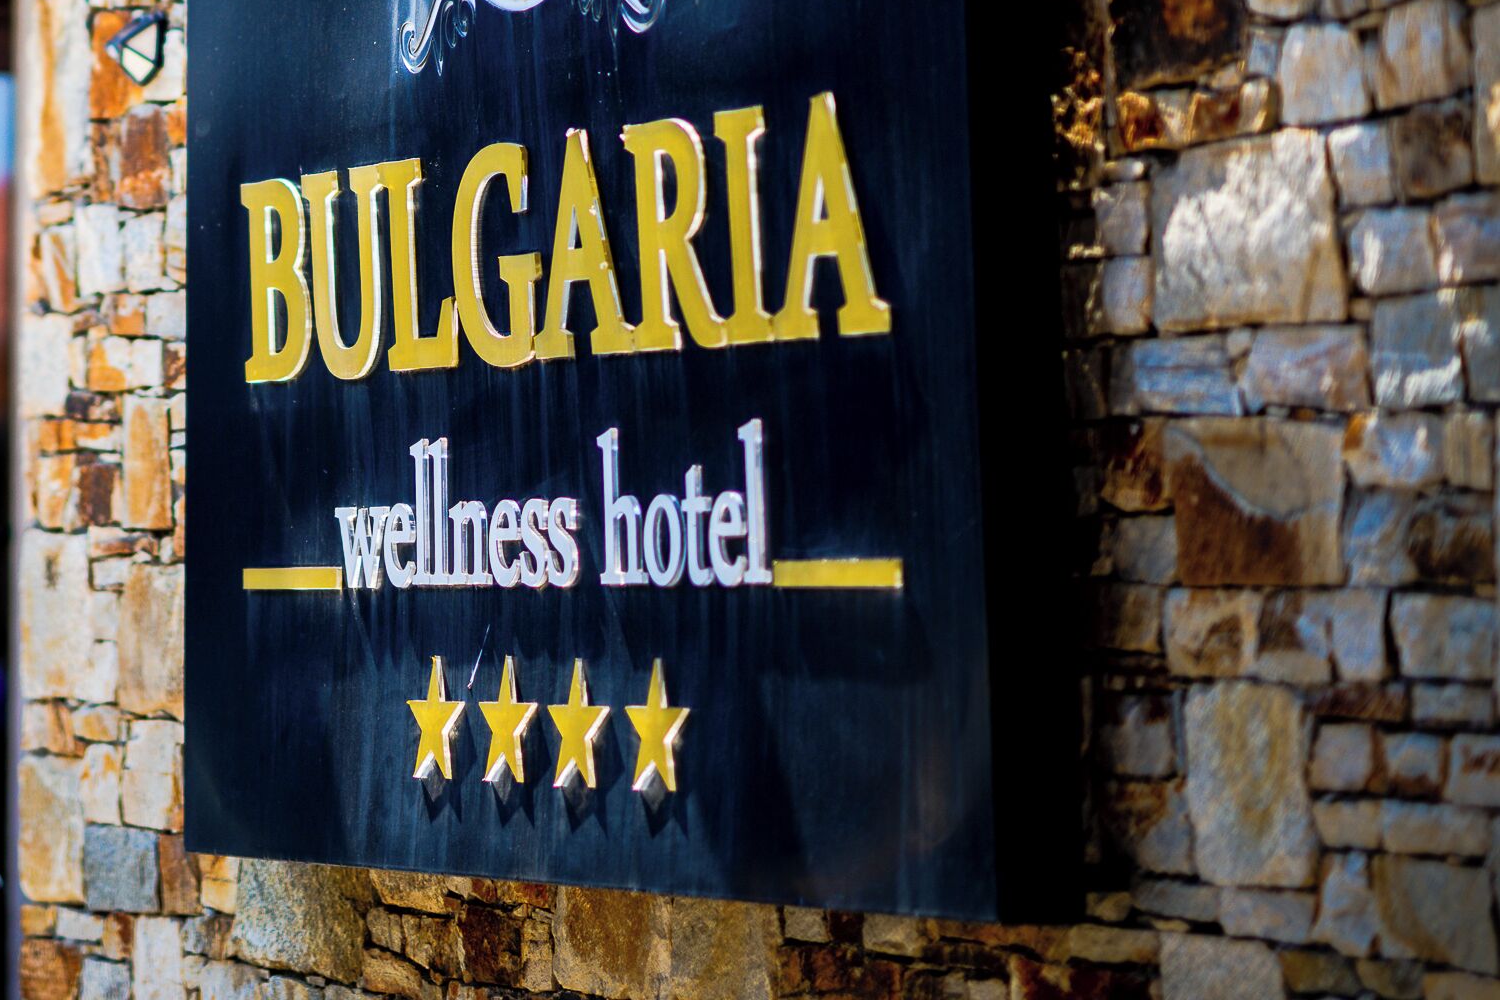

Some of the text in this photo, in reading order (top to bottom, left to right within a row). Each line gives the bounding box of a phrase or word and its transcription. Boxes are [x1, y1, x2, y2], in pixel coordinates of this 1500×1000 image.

[240, 90, 893, 384] BULGARIA
[335, 418, 773, 590] wellness hotel
